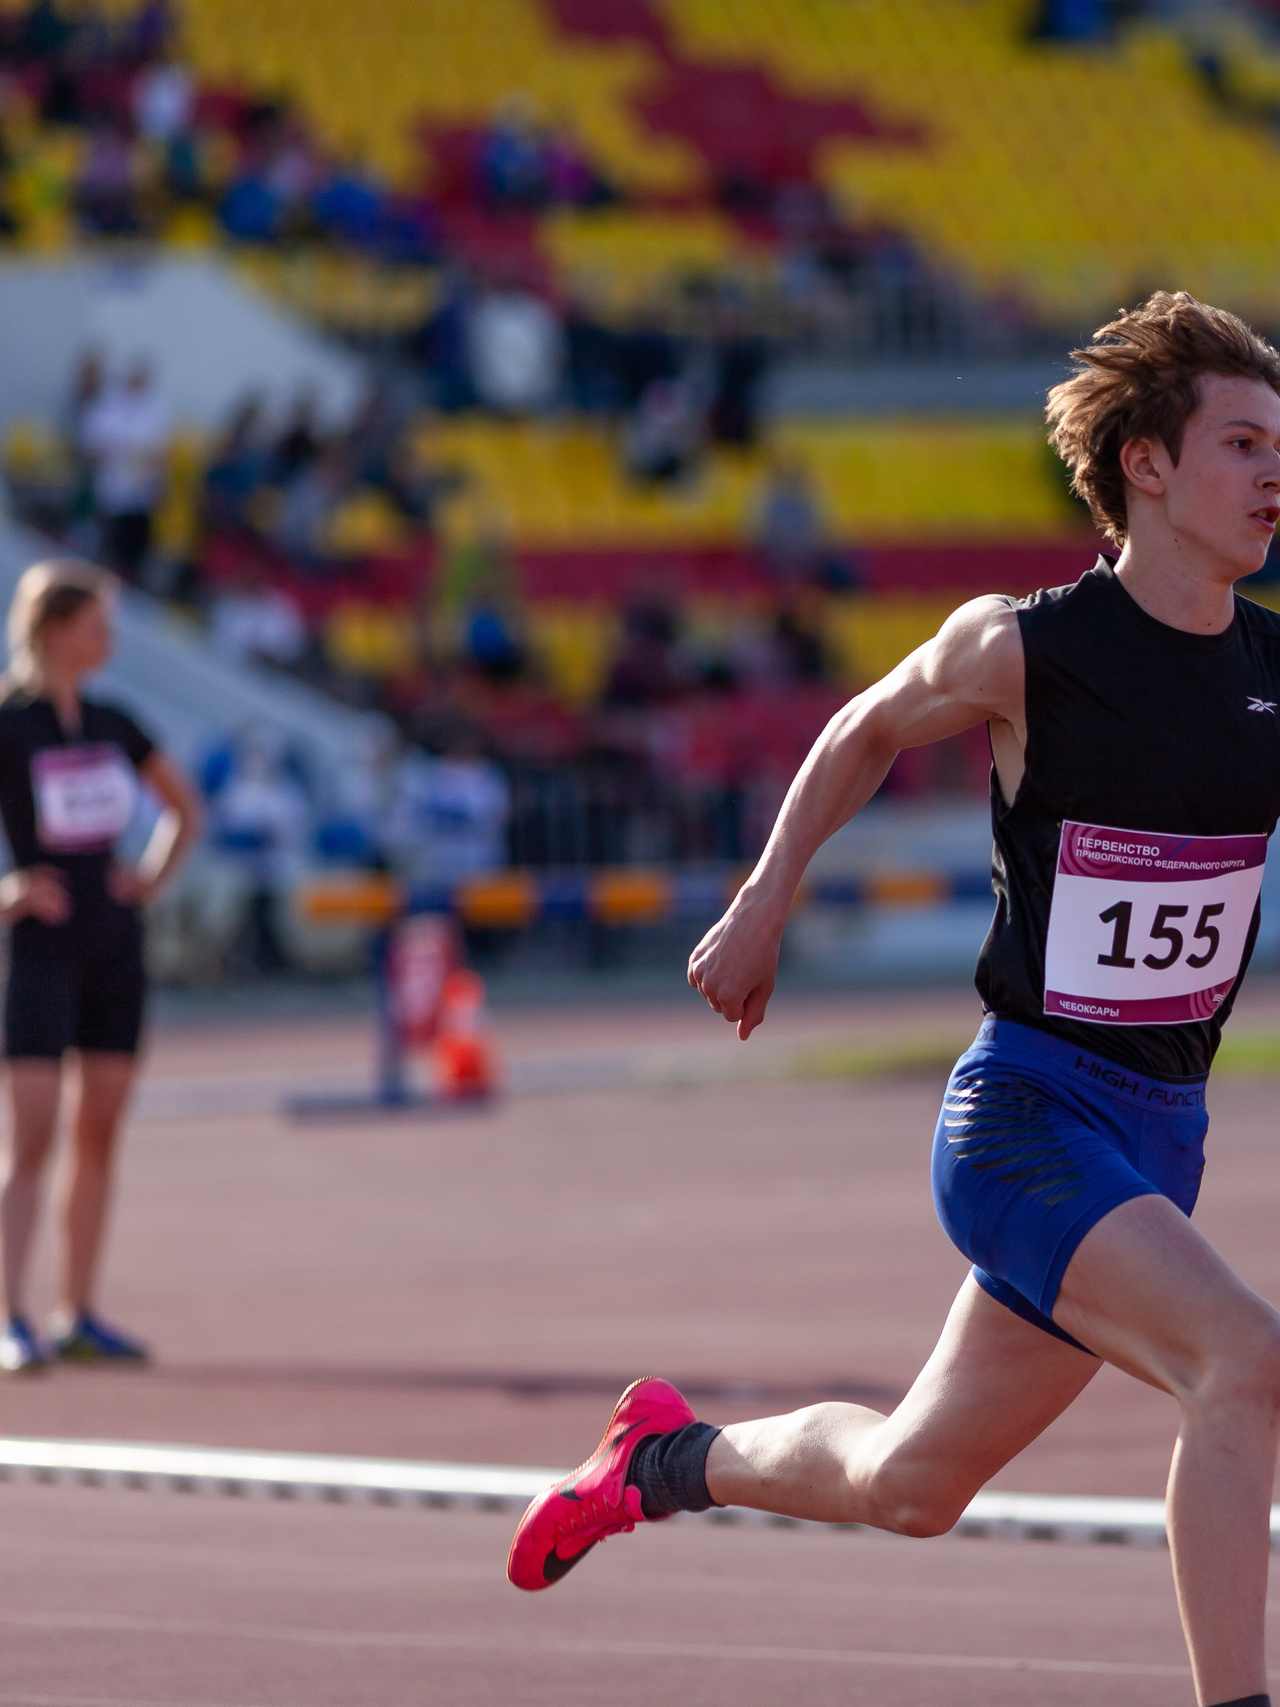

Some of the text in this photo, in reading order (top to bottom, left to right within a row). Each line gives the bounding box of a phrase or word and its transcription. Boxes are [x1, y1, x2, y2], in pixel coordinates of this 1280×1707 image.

[1077, 836, 1160, 857] ПЕРВЕНСТВО
[1075, 849, 1246, 871] ПРИВОЛЖСКОГО ФЕДЕРАЛЬНОГО ОКРУГА
[1097, 901, 1225, 970] 155
[1059, 1000, 1119, 1017] ЧЕБОКСАРЫ
[1075, 1055, 1139, 1094] HIGH
